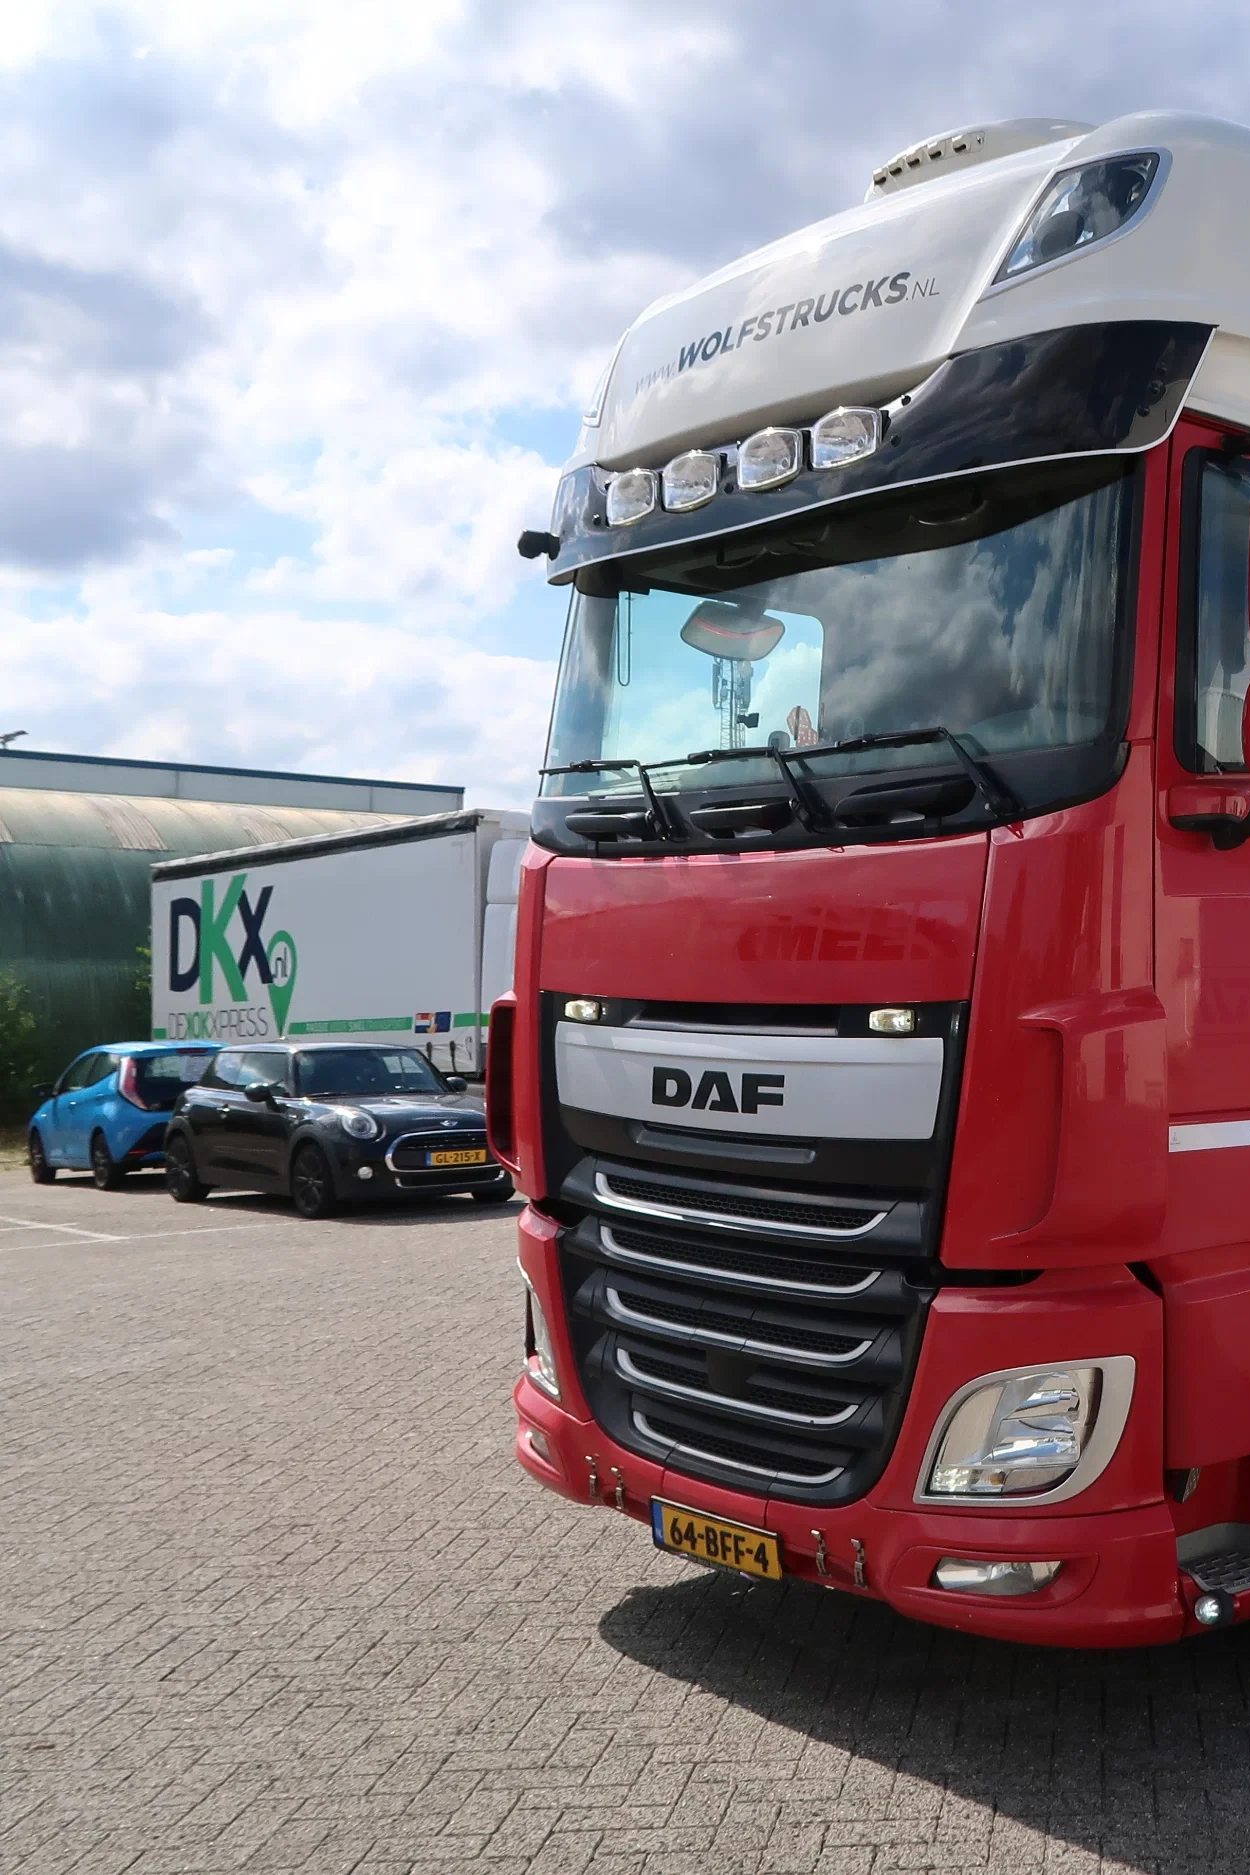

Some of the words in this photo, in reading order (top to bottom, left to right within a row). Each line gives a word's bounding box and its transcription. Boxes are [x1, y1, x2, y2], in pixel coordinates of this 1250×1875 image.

[652, 1066, 785, 1114] DAF
[435, 1151, 481, 1164] GL-215-X
[669, 1517, 770, 1573] 64-BFF-4
